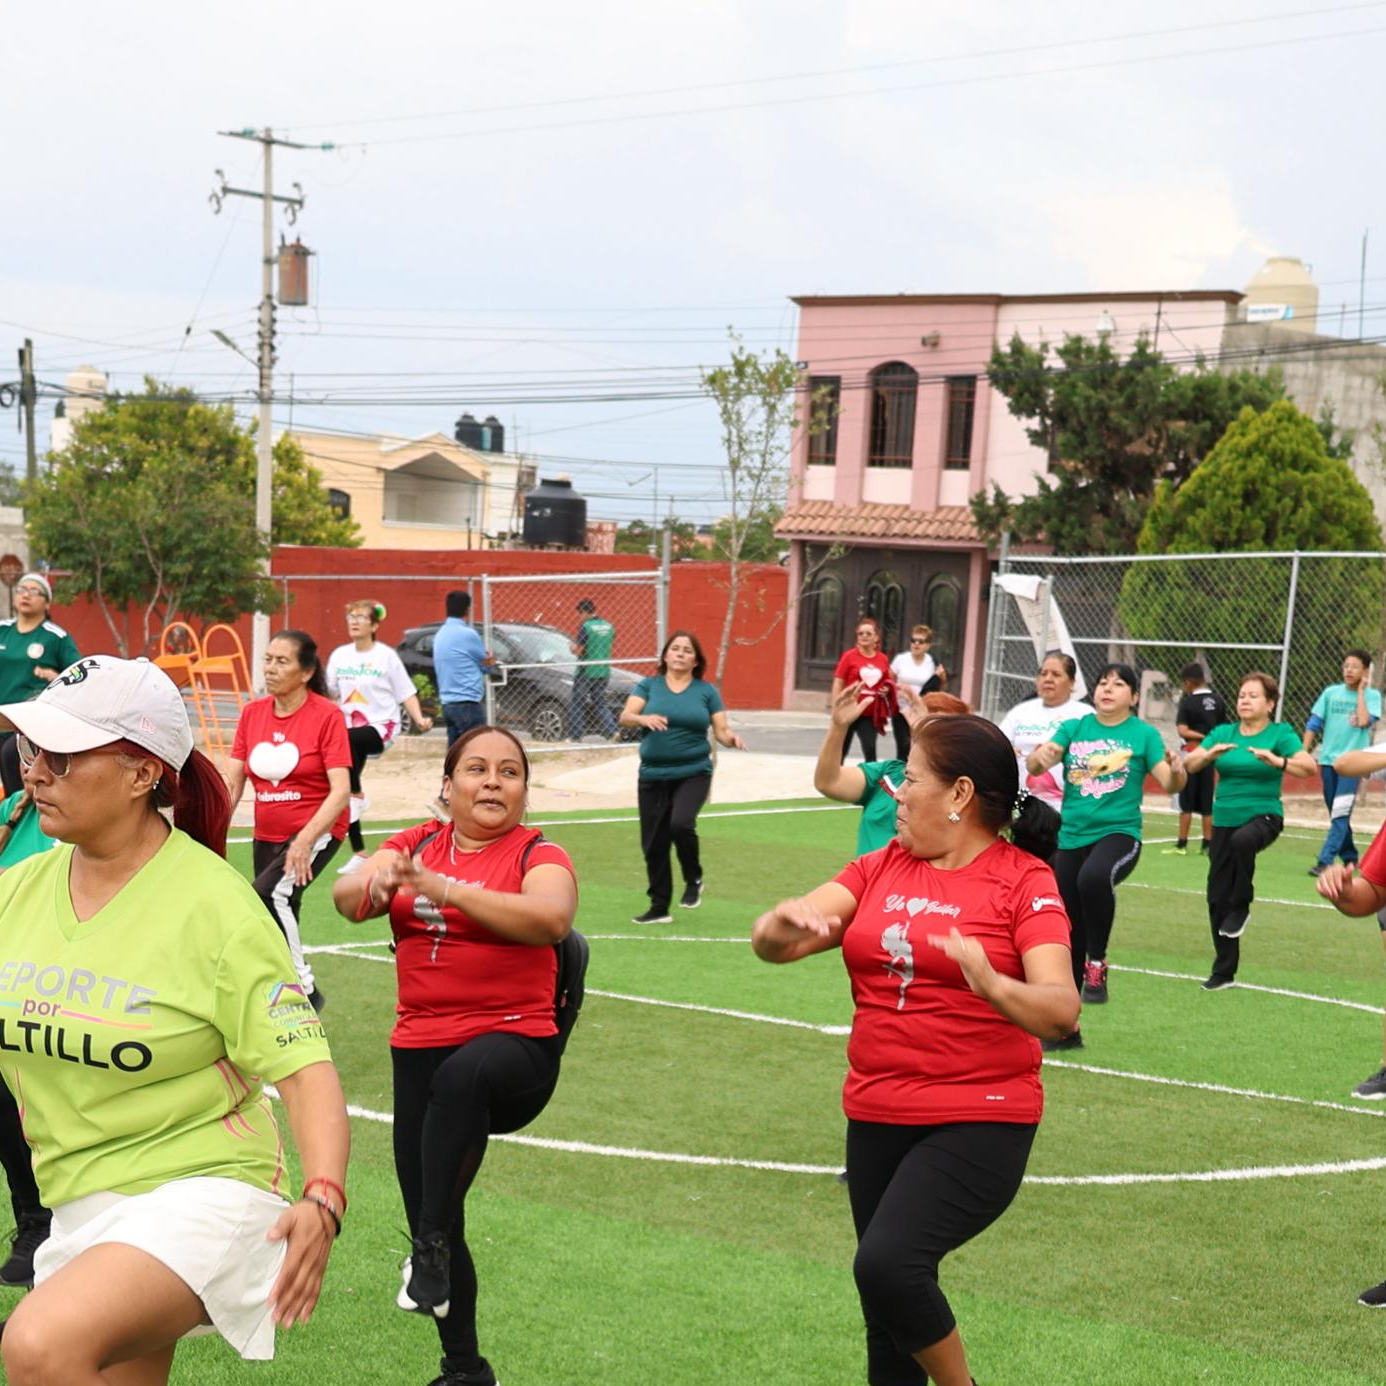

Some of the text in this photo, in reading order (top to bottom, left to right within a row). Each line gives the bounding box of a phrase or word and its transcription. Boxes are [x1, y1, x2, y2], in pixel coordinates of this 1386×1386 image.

[272, 731, 286, 743] Yo
[883, 894, 905, 914] Yo
[22, 998, 62, 1018] por
